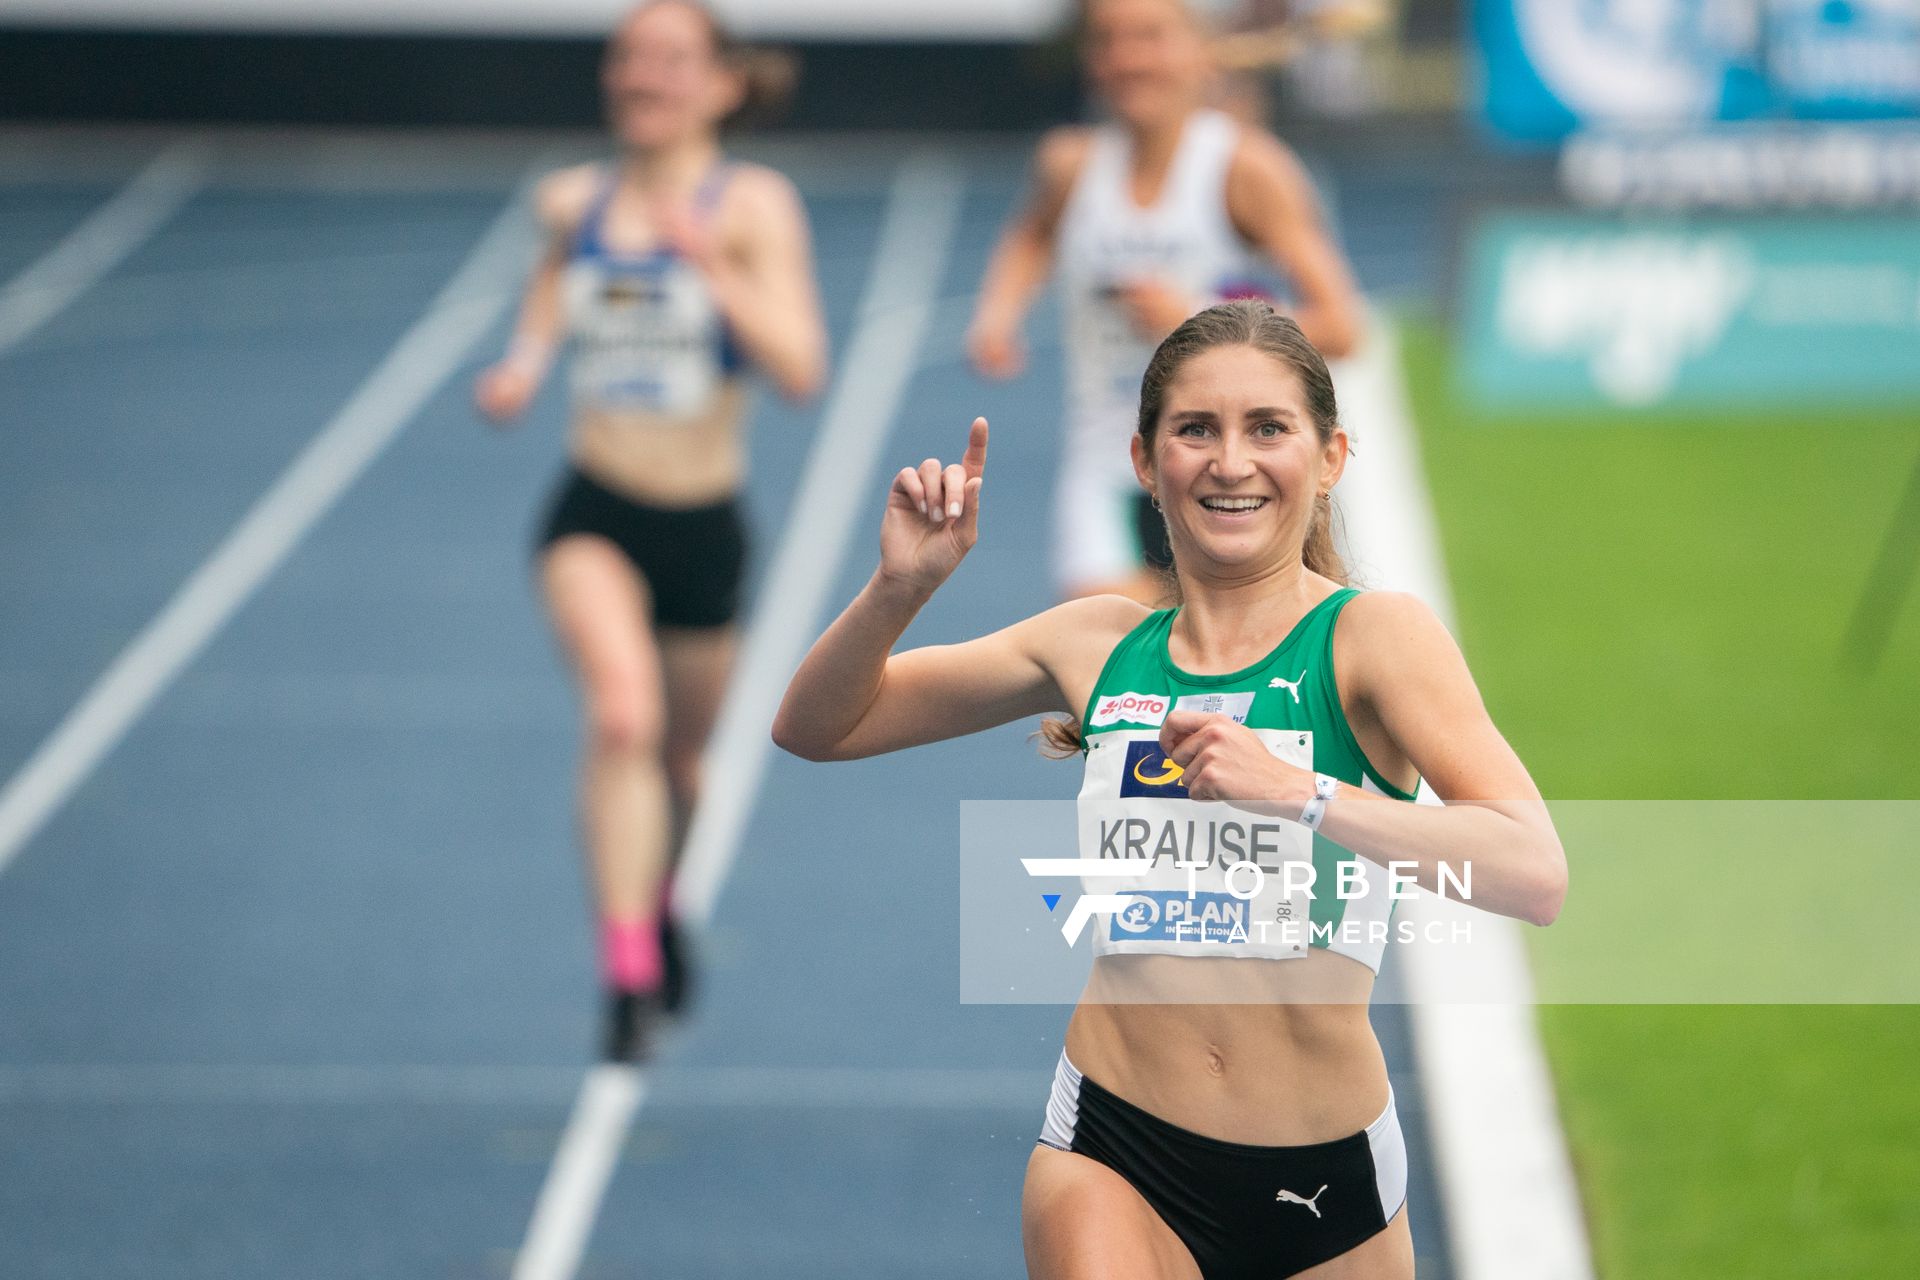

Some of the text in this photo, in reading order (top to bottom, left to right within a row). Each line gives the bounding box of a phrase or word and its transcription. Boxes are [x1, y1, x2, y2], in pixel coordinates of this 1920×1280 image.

[1099, 818, 1281, 875] KRAUSE
[1165, 899, 1244, 924] PLAN
[1165, 925, 1243, 937] INRNTIONL
